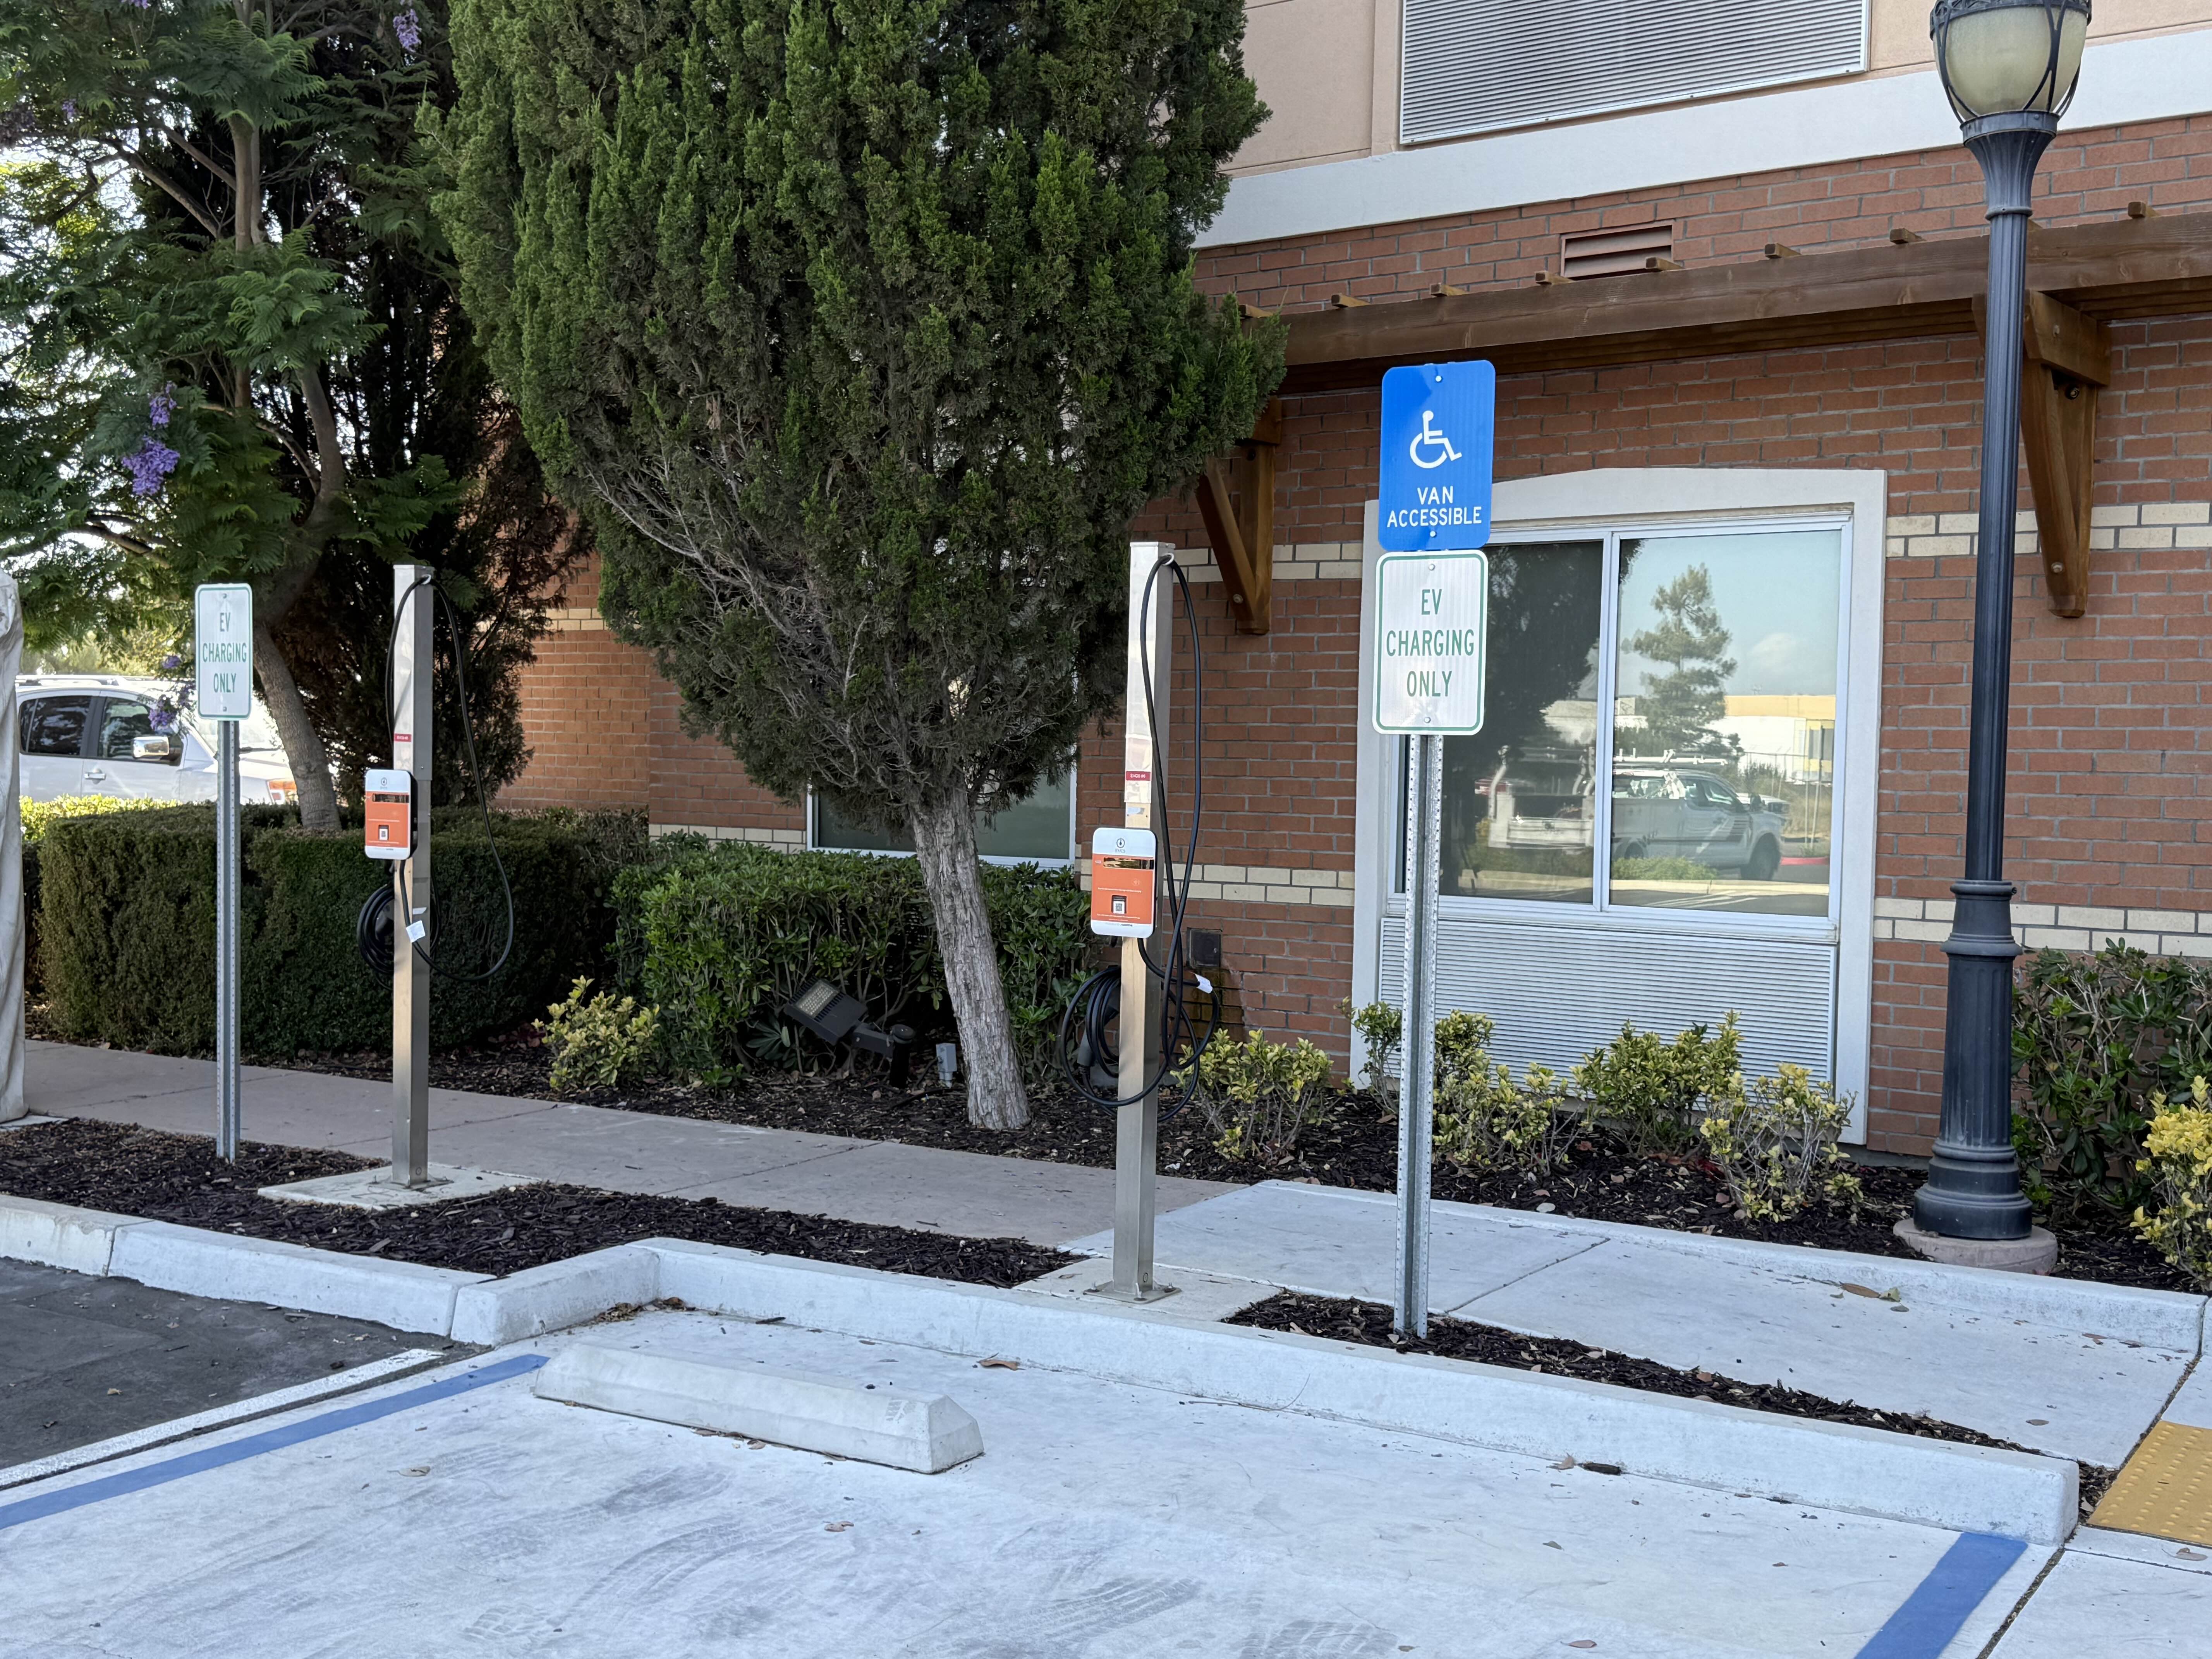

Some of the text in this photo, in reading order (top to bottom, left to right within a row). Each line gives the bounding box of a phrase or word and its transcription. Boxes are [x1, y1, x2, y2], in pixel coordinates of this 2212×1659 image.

[1417, 486, 1453, 505] VAN
[1386, 506, 1482, 527] ACCESSIBLE
[1421, 589, 1442, 615] EV
[220, 612, 231, 632] EV
[203, 642, 247, 663] CHARGING
[1386, 629, 1474, 656] CHARGING
[213, 673, 237, 693] ONLY
[1407, 670, 1453, 697] ONLY
